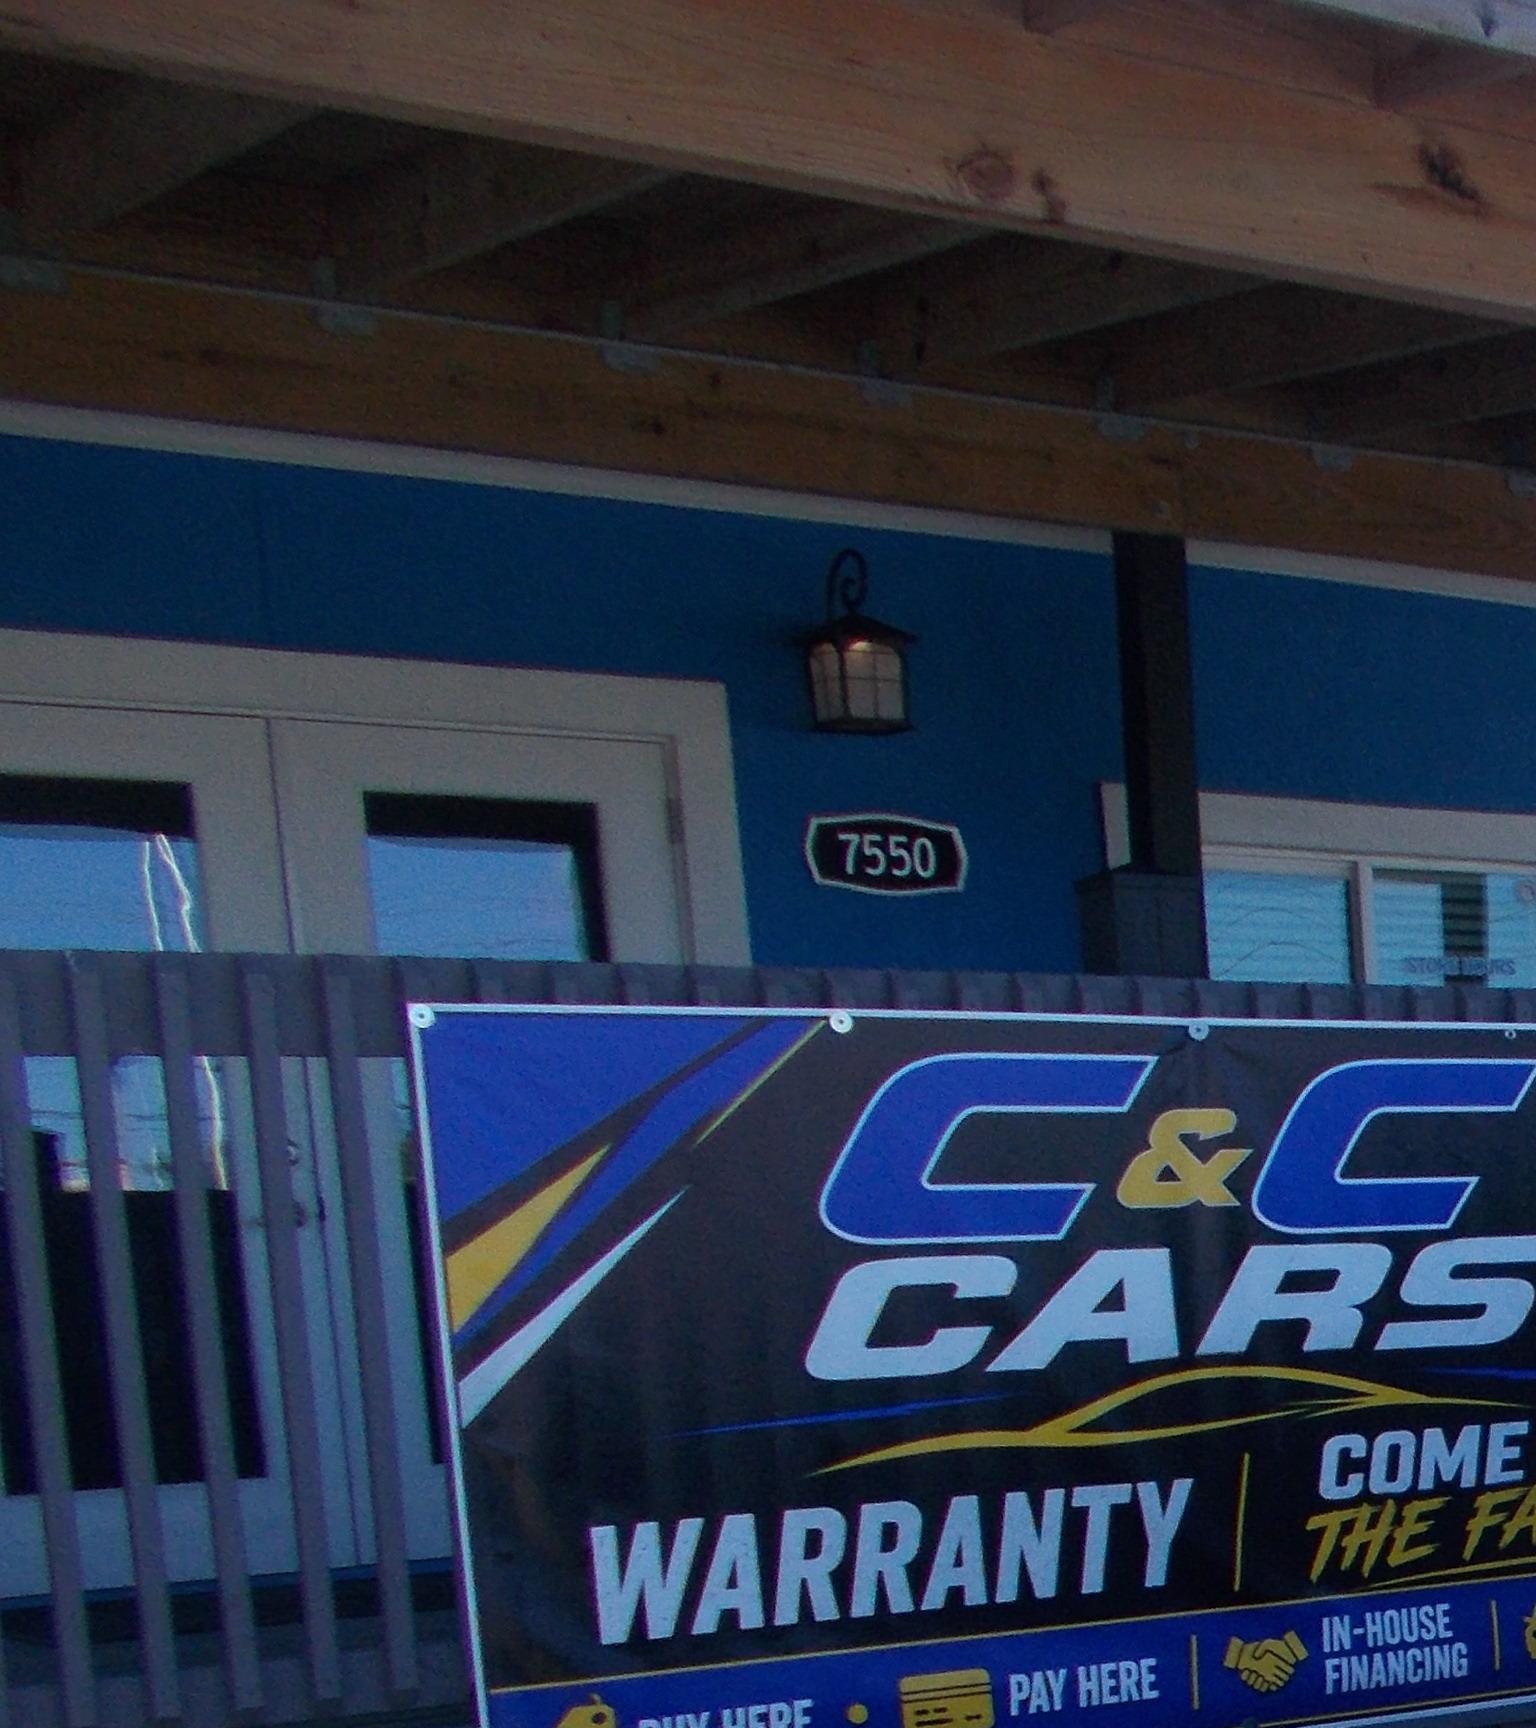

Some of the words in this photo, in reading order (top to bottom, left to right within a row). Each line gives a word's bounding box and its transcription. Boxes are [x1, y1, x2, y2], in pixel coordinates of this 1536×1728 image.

[837, 833, 938, 879] 7550
[1318, 1420, 1530, 1501] COME
[589, 1477, 1194, 1646] WARRANTY
[1305, 1496, 1455, 1585] THE
[1321, 1603, 1454, 1653] IN-HOUSE
[1008, 1667, 1069, 1716] PAY
[1077, 1657, 1160, 1707] HERE
[1324, 1643, 1469, 1696] FINANCING
